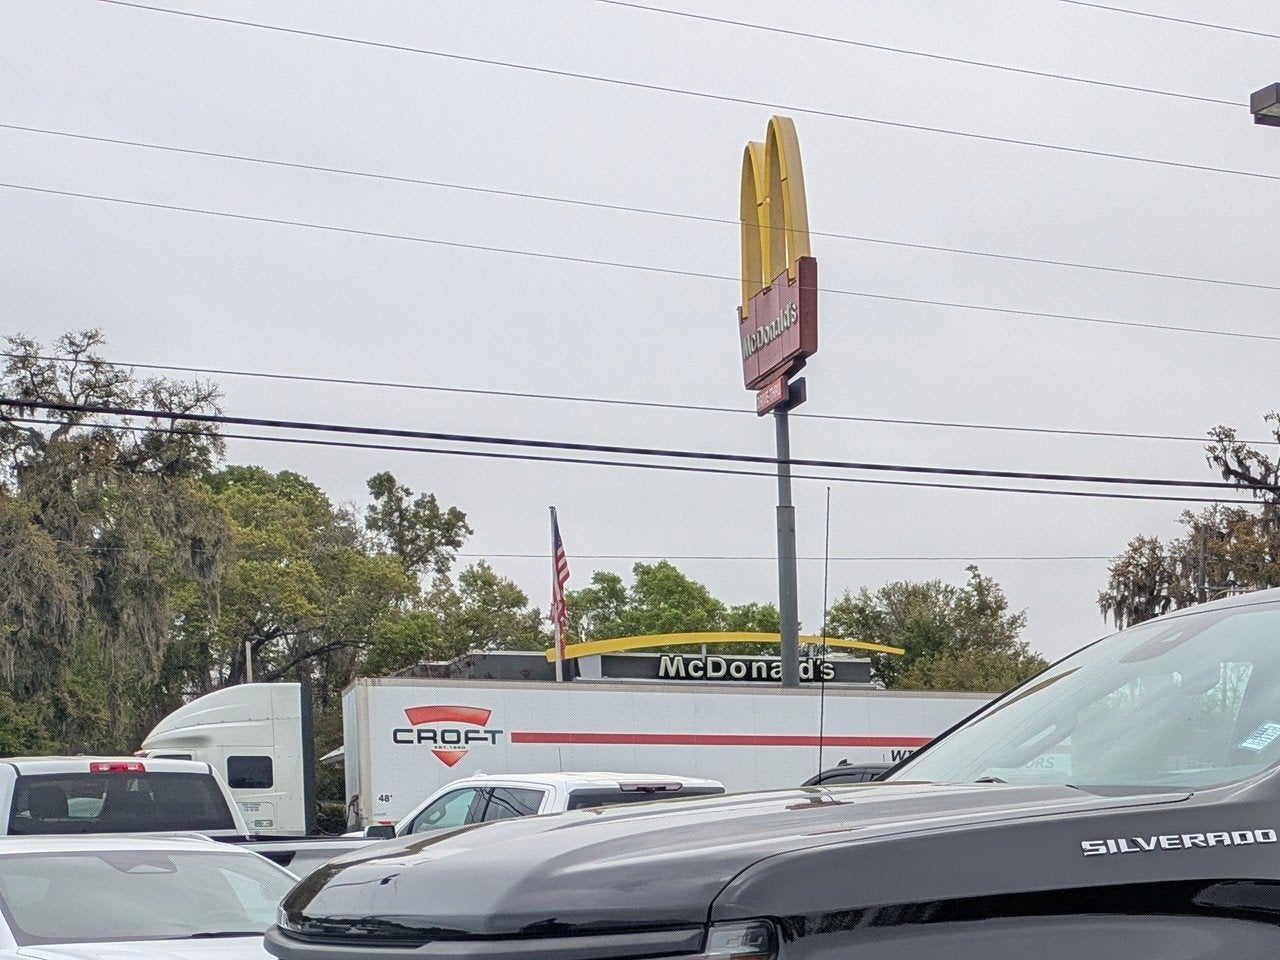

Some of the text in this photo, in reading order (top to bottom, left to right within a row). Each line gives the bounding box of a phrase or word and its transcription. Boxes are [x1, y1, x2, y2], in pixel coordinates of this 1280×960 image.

[742, 301, 798, 360] McDonald's
[658, 655, 836, 680] McDonad's
[392, 728, 504, 745] CROFT
[1080, 828, 1279, 857] SILVERADO
